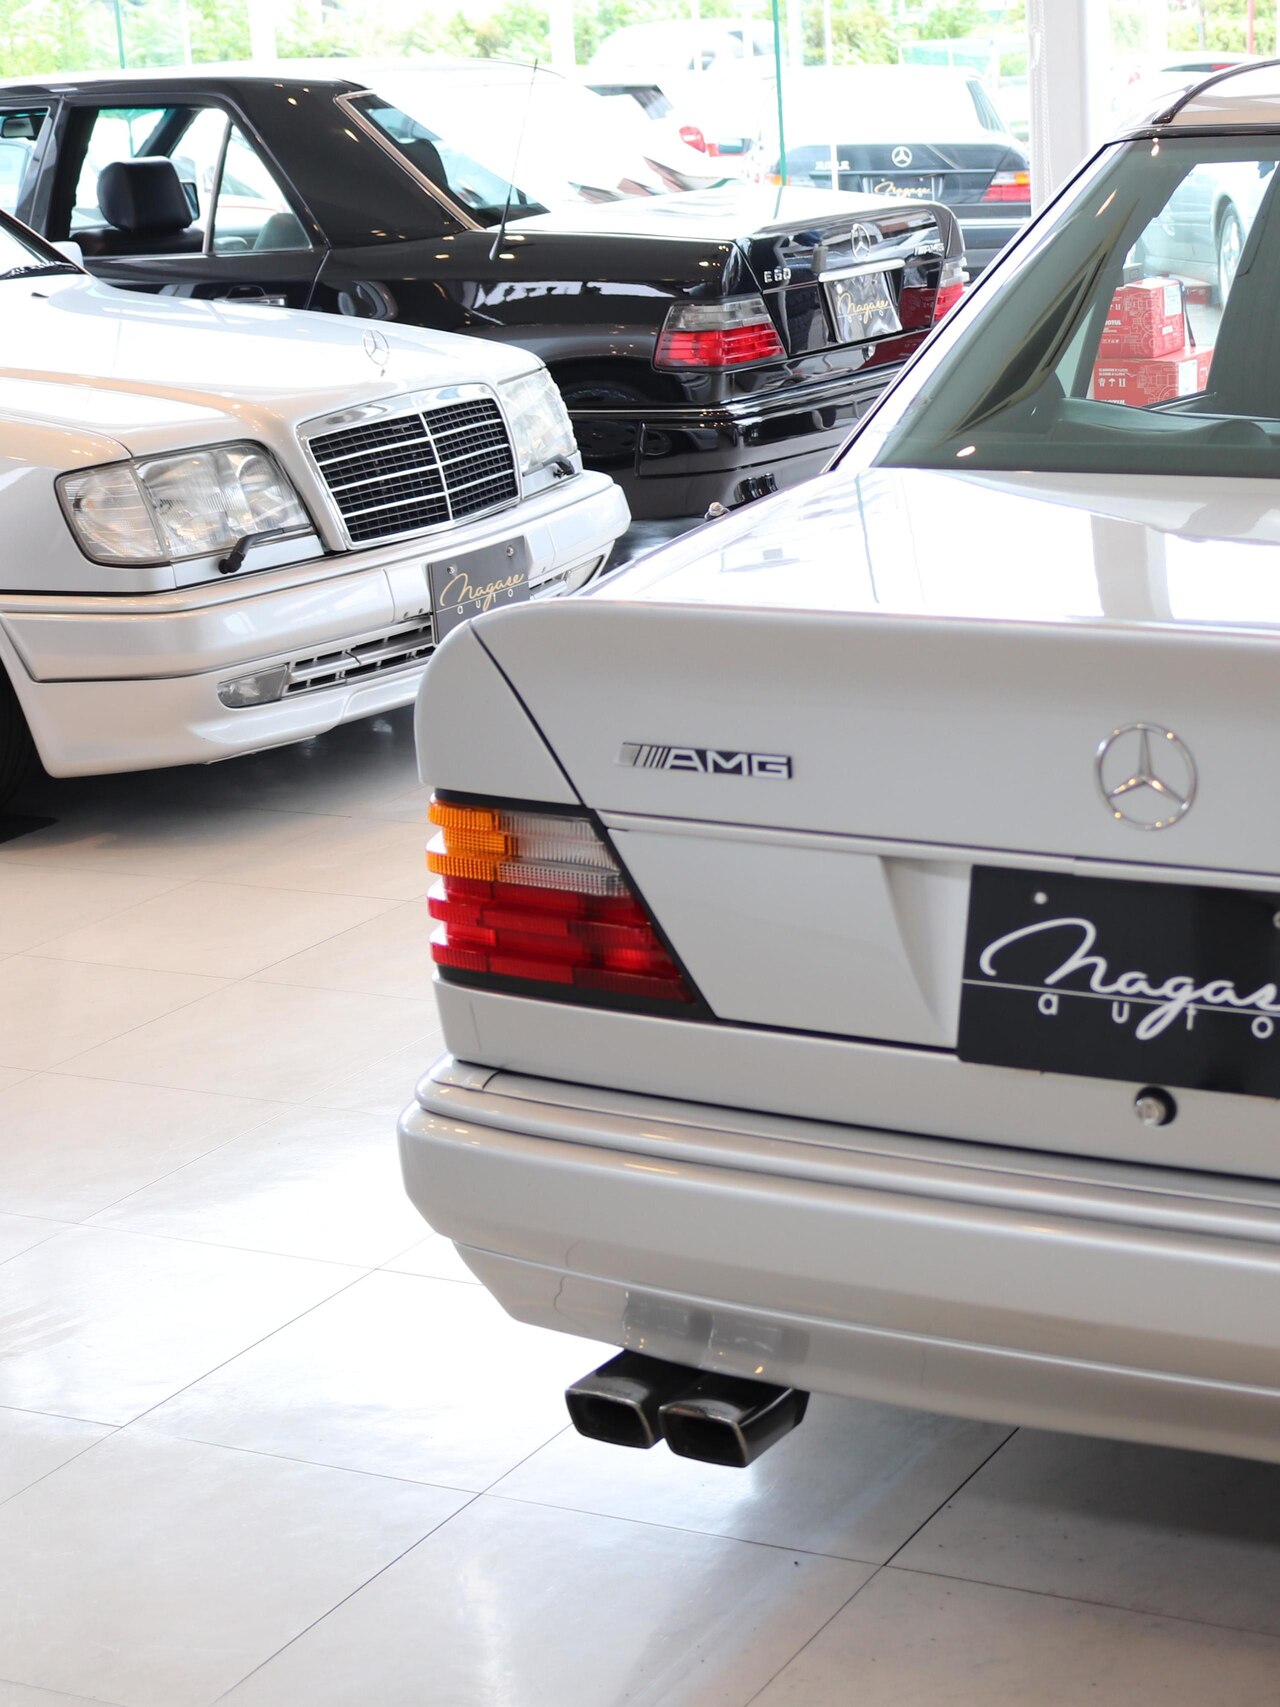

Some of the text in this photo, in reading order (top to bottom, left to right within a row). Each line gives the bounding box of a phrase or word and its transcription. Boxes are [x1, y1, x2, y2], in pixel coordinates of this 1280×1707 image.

[837, 292, 888, 324] Nagase
[440, 572, 524, 612] Nagase
[663, 747, 791, 780] AMG
[1038, 992, 1274, 1038] auto
